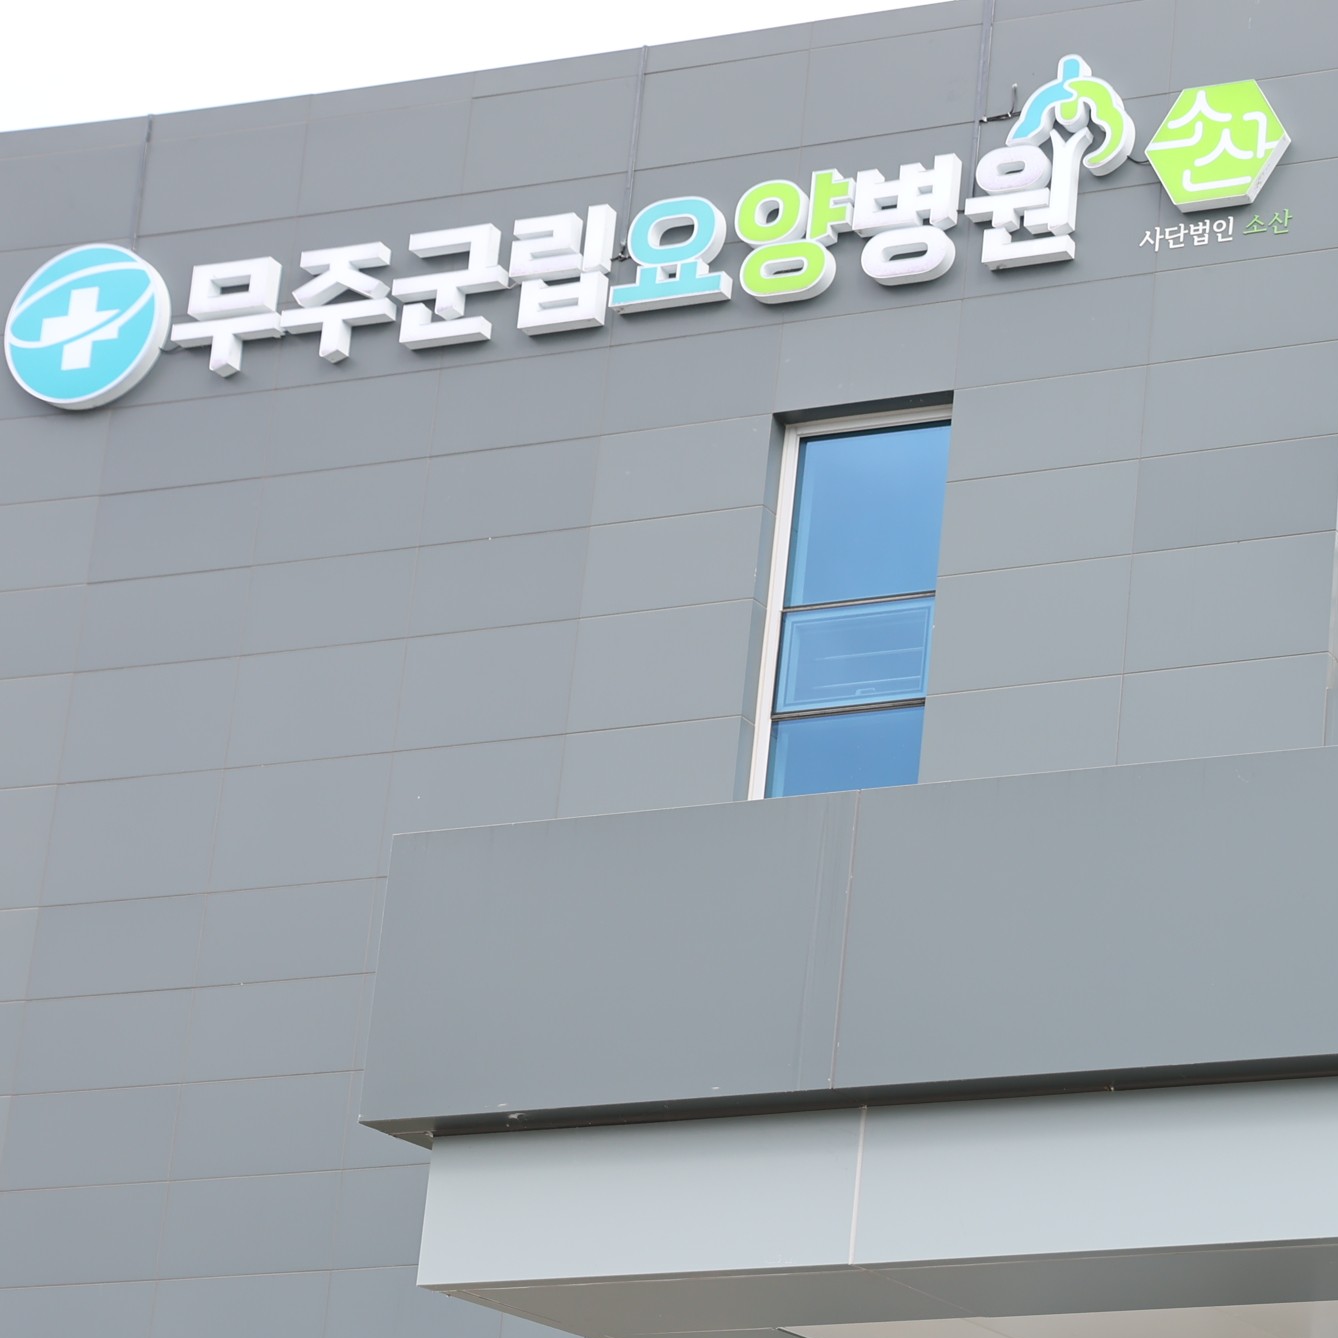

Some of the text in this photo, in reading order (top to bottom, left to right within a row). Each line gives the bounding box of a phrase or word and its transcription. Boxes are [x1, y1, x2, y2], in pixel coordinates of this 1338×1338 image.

[171, 127, 1093, 378] 무주군립요양병원
[1139, 208, 1293, 252] 사단법인 소산
